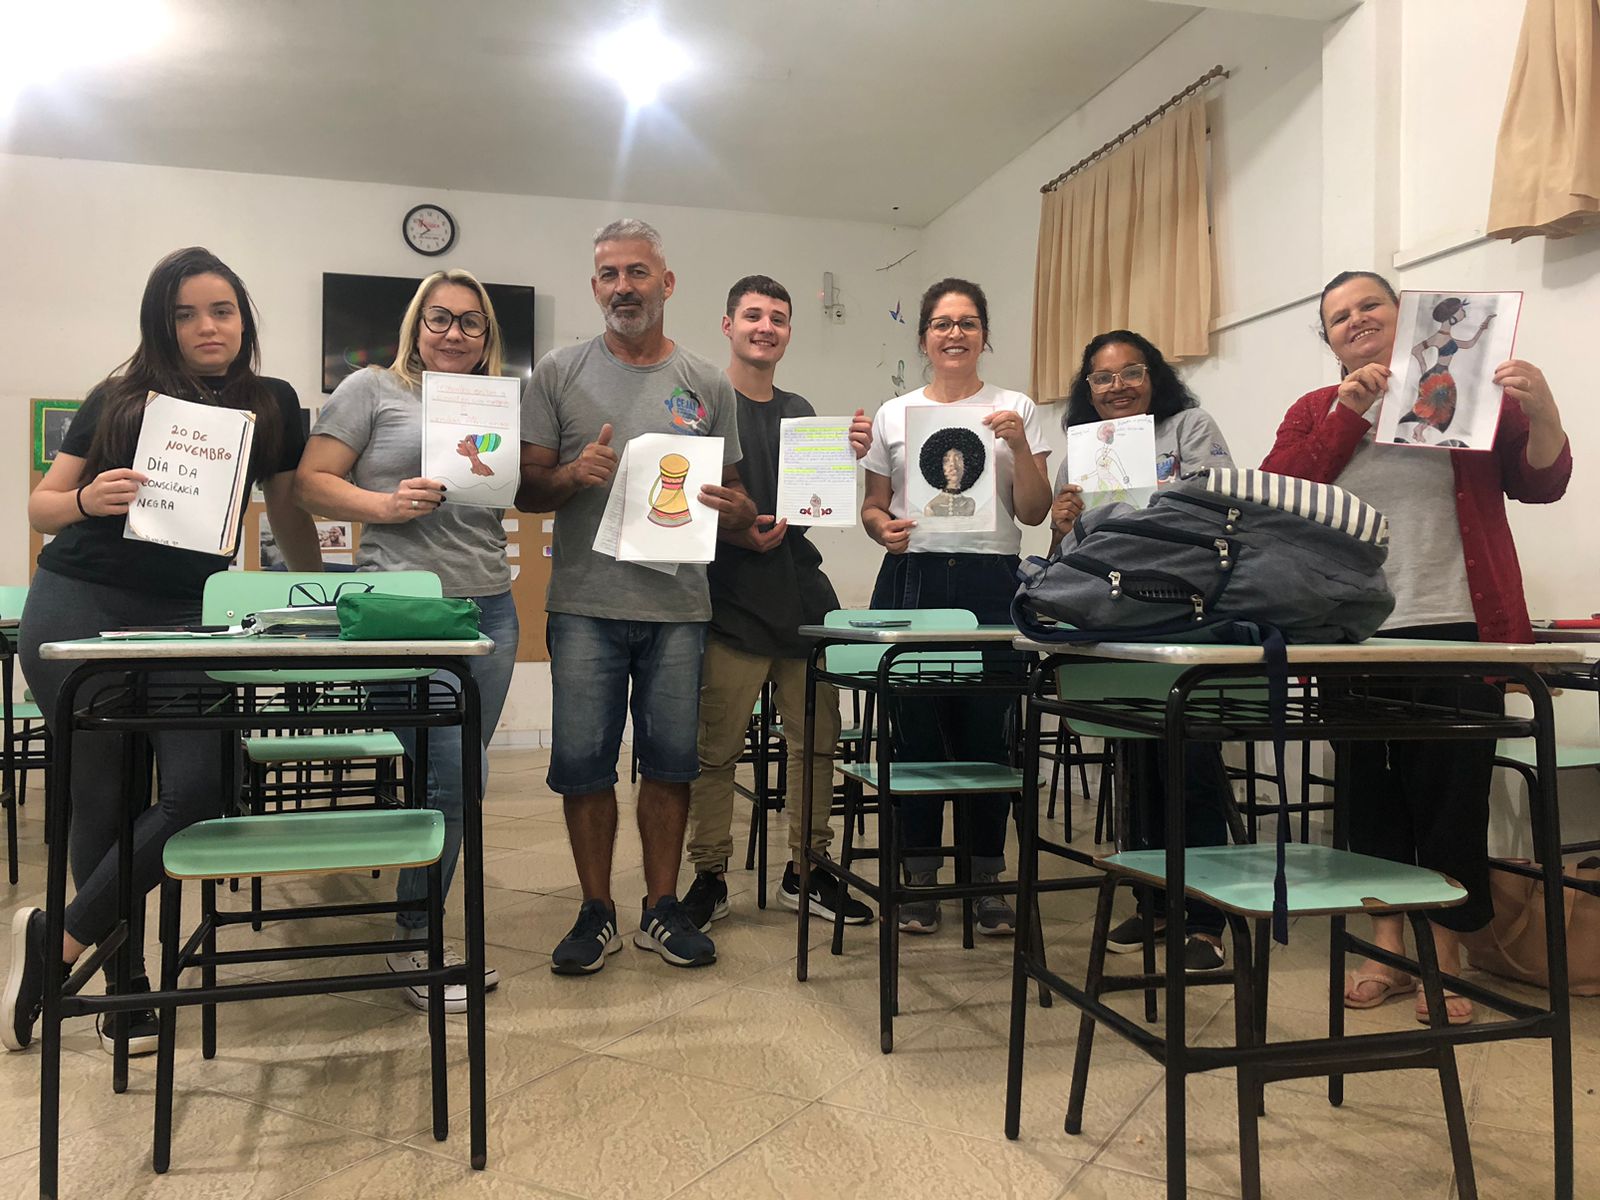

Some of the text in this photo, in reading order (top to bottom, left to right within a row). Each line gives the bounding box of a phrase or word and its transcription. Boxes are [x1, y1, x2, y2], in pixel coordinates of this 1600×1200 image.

[171, 424, 208, 441] 20 DE
[165, 440, 232, 460] NOVEMBRO
[178, 464, 198, 478] DA
[136, 498, 175, 510] NEGRA
